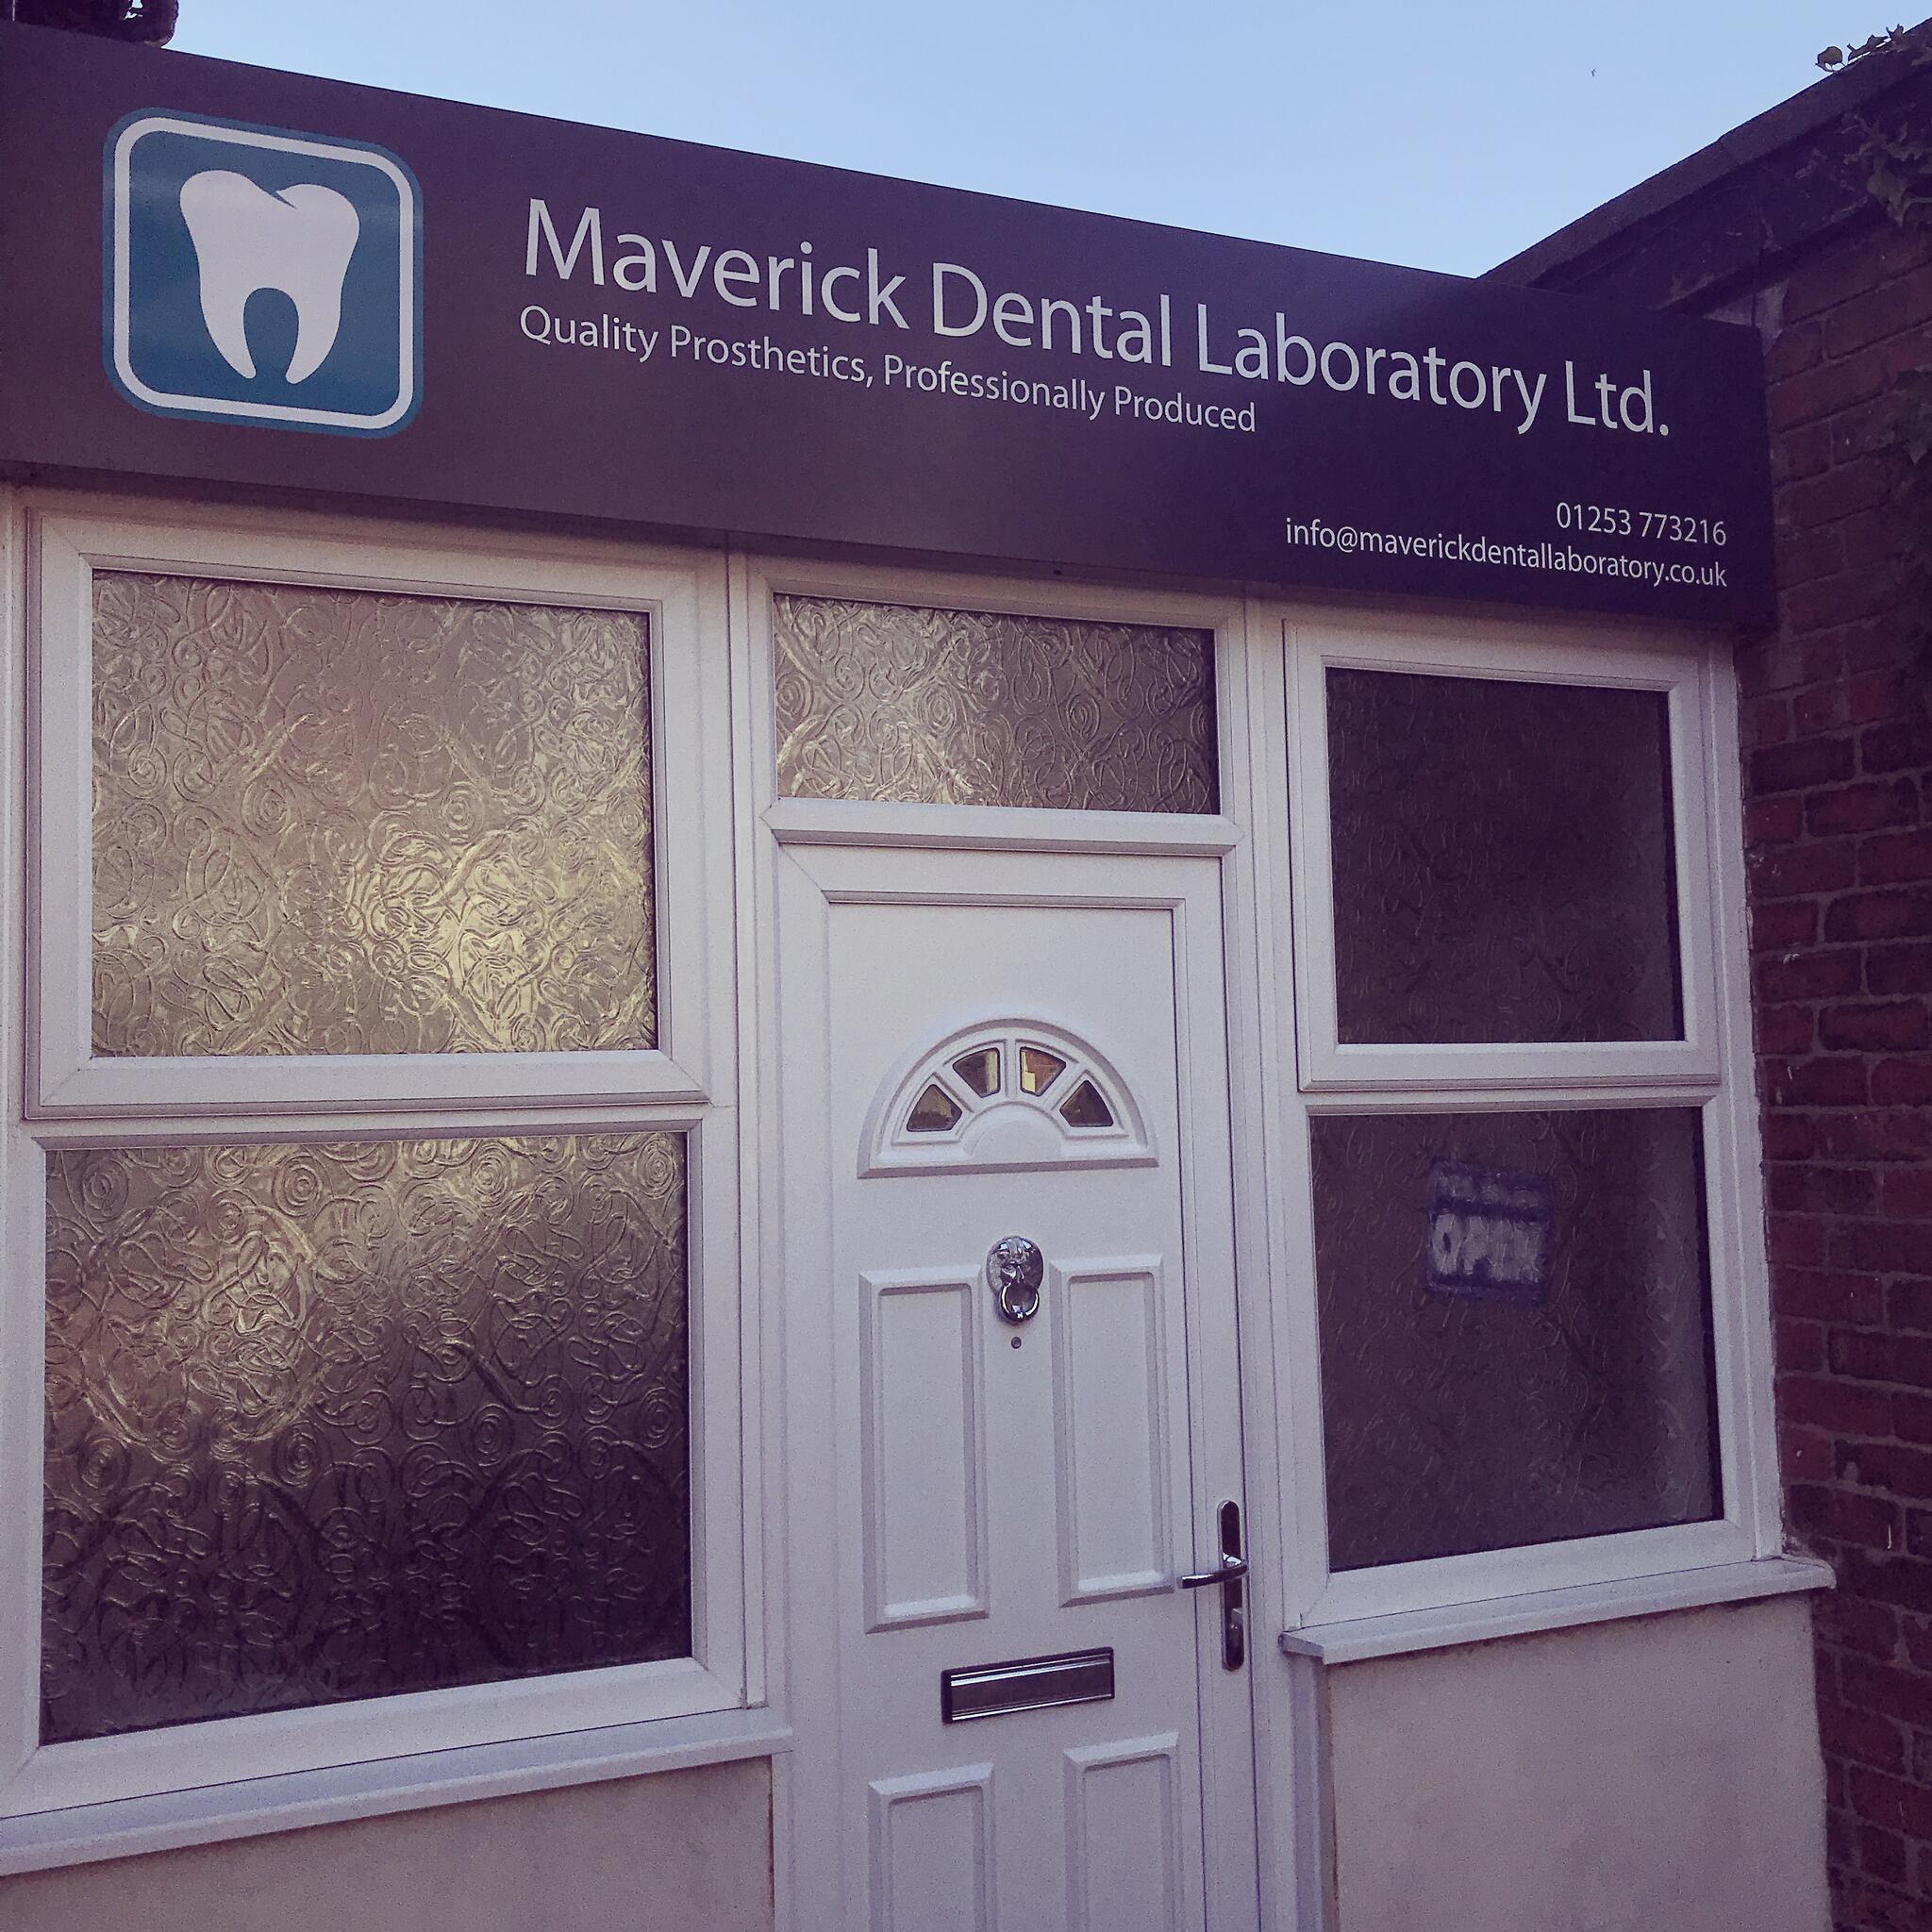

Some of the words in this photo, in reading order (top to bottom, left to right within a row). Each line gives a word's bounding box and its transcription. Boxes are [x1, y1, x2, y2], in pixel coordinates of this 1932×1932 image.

[525, 197, 910, 330] Maverick
[932, 262, 1172, 367] Dental
[1197, 303, 1548, 435] Laboratory
[1565, 359, 1669, 436] Ltd.
[520, 305, 659, 363] Quality
[671, 325, 874, 389] Prosthetics,
[884, 354, 1106, 421] Professionally
[1114, 385, 1256, 432] Produced
[1285, 516, 1728, 588] info@maverickdentallaboratory.co.uk
[1556, 502, 1632, 536] 01253
[1639, 511, 1727, 547] 773216
